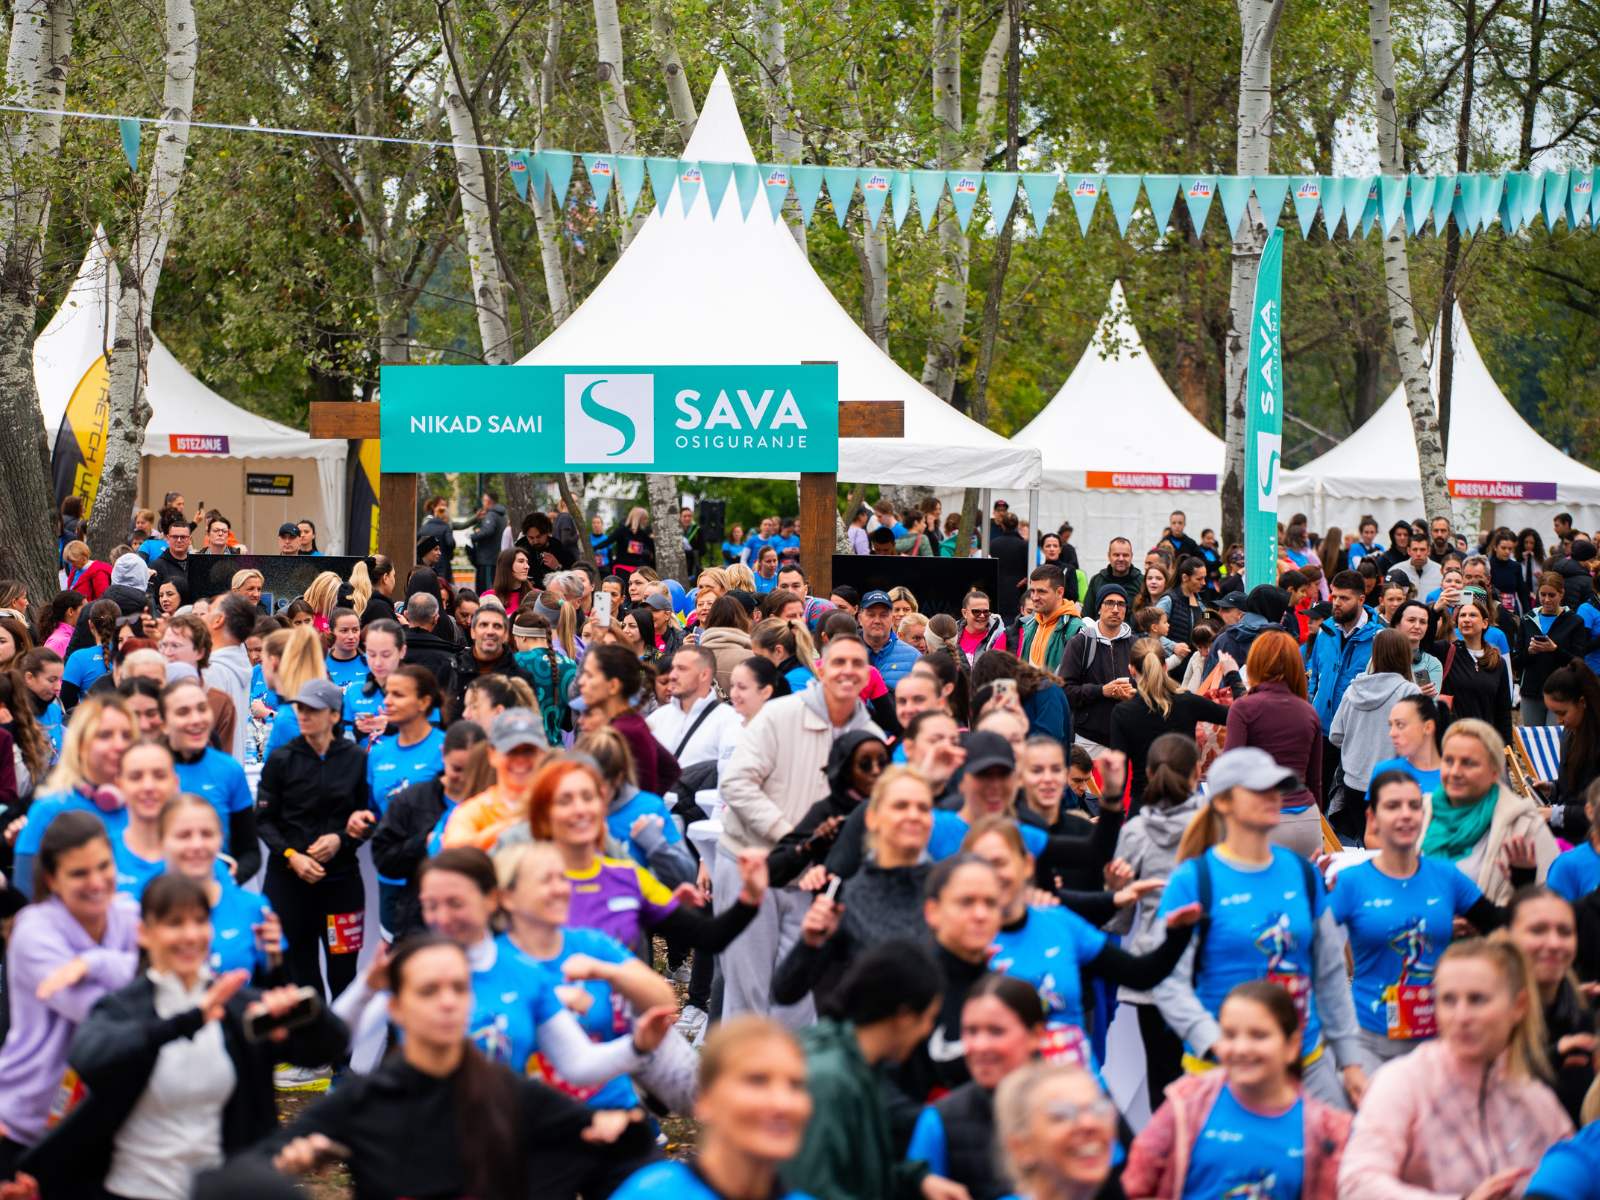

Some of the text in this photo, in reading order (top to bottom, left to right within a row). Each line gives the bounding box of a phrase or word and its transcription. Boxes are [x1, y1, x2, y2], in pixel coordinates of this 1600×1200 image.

[594, 160, 609, 170] dm
[770, 171, 786, 181] dm
[870, 175, 885, 186] dm
[959, 178, 975, 189] dm
[1079, 180, 1094, 191] dm
[1193, 181, 1209, 192] dm
[1302, 182, 1317, 193] dm
[1260, 299, 1275, 415] SAVA
[674, 389, 808, 430] SAVA
[410, 415, 543, 434] NIKAD SAMI
[176, 437, 222, 451] ISTEZANJE
[675, 435, 808, 449] OSIGURANJE
[1112, 474, 1192, 488] CHANGING TENT
[1454, 481, 1524, 497] PRESVLAČENJE
